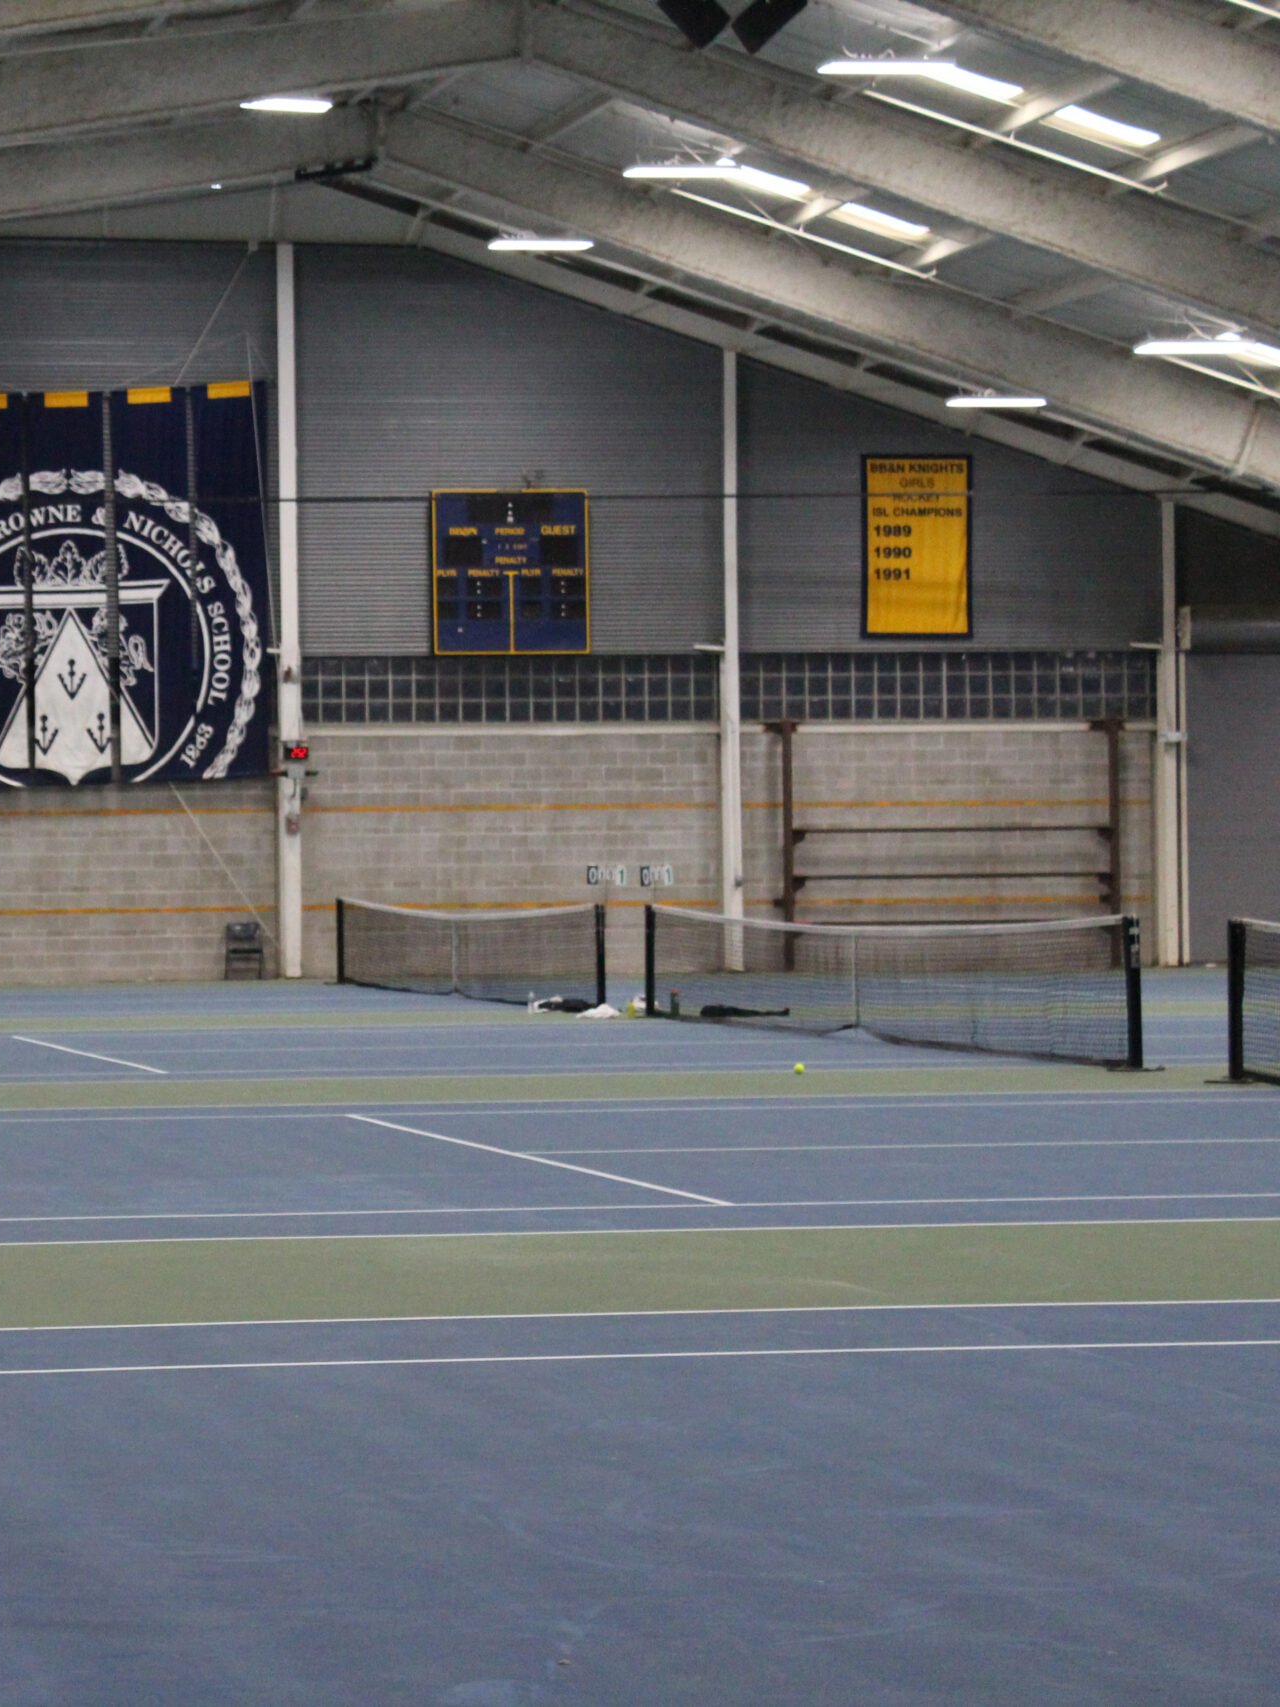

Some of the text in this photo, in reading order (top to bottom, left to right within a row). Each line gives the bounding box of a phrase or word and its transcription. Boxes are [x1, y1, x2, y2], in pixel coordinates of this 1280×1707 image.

[909, 463, 964, 473] KNIGHTS
[899, 478, 935, 489] GIRLS
[872, 507, 963, 517] ISL CHAMPIONS
[540, 525, 576, 536] GUEST
[874, 525, 912, 537] 1989
[875, 546, 912, 559] 1990
[874, 568, 911, 580] 1991
[207, 601, 232, 706] SCHOOL
